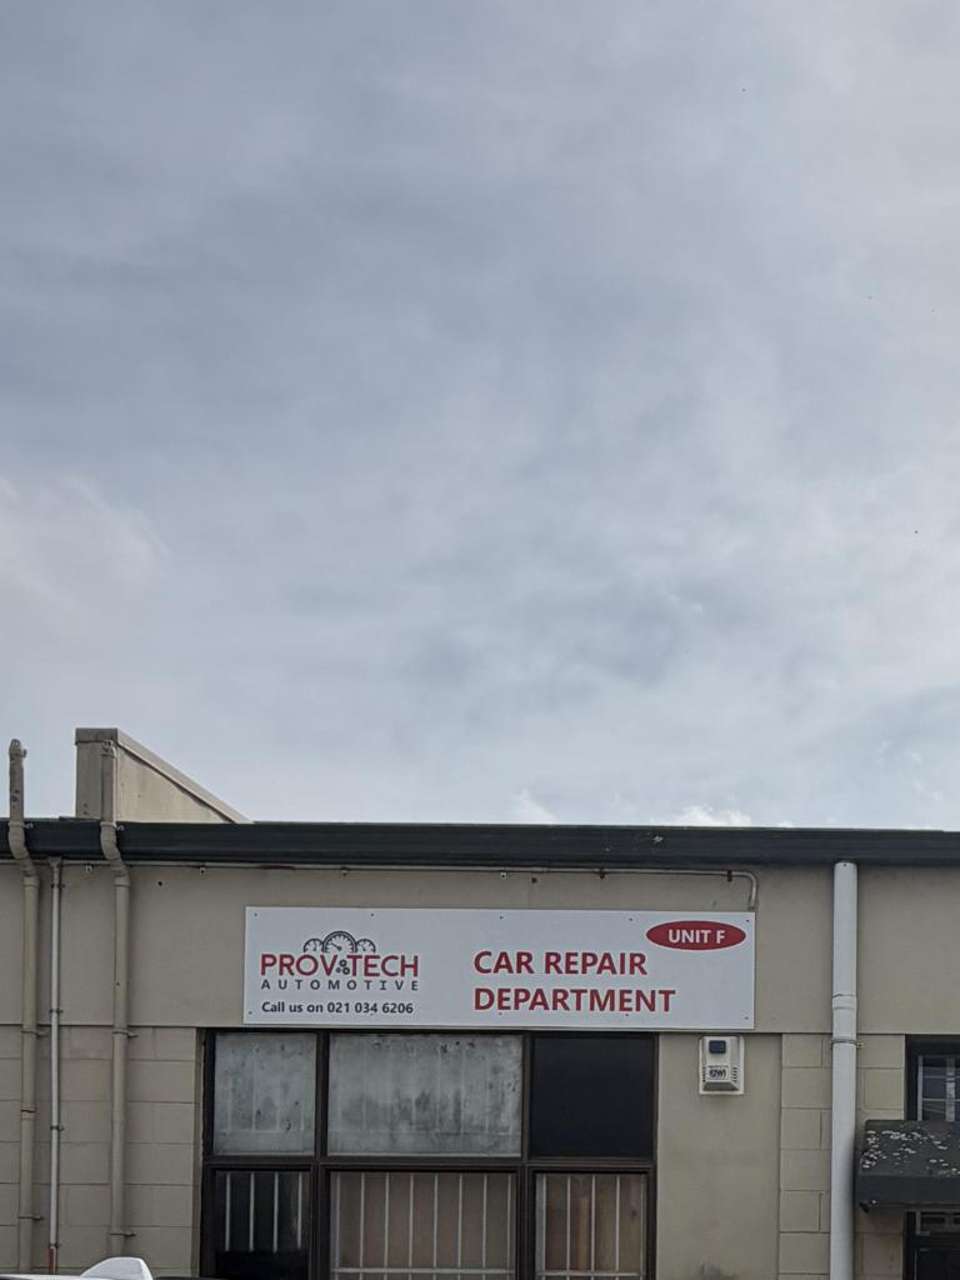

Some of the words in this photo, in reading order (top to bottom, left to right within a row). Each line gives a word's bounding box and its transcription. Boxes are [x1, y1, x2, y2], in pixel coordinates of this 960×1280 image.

[668, 929, 711, 944] UNIT
[716, 929, 726, 944] F
[473, 951, 535, 974] CAR
[544, 951, 648, 976] REPAIR
[261, 979, 418, 991] AUTOMOTIVE
[474, 987, 676, 1012] DEPARTMENT
[261, 1001, 285, 1013] Call
[289, 1003, 302, 1013] us
[306, 1003, 323, 1013] on
[327, 1002, 350, 1013] 021
[354, 1002, 378, 1013] 034
[382, 1002, 414, 1014] 6206
